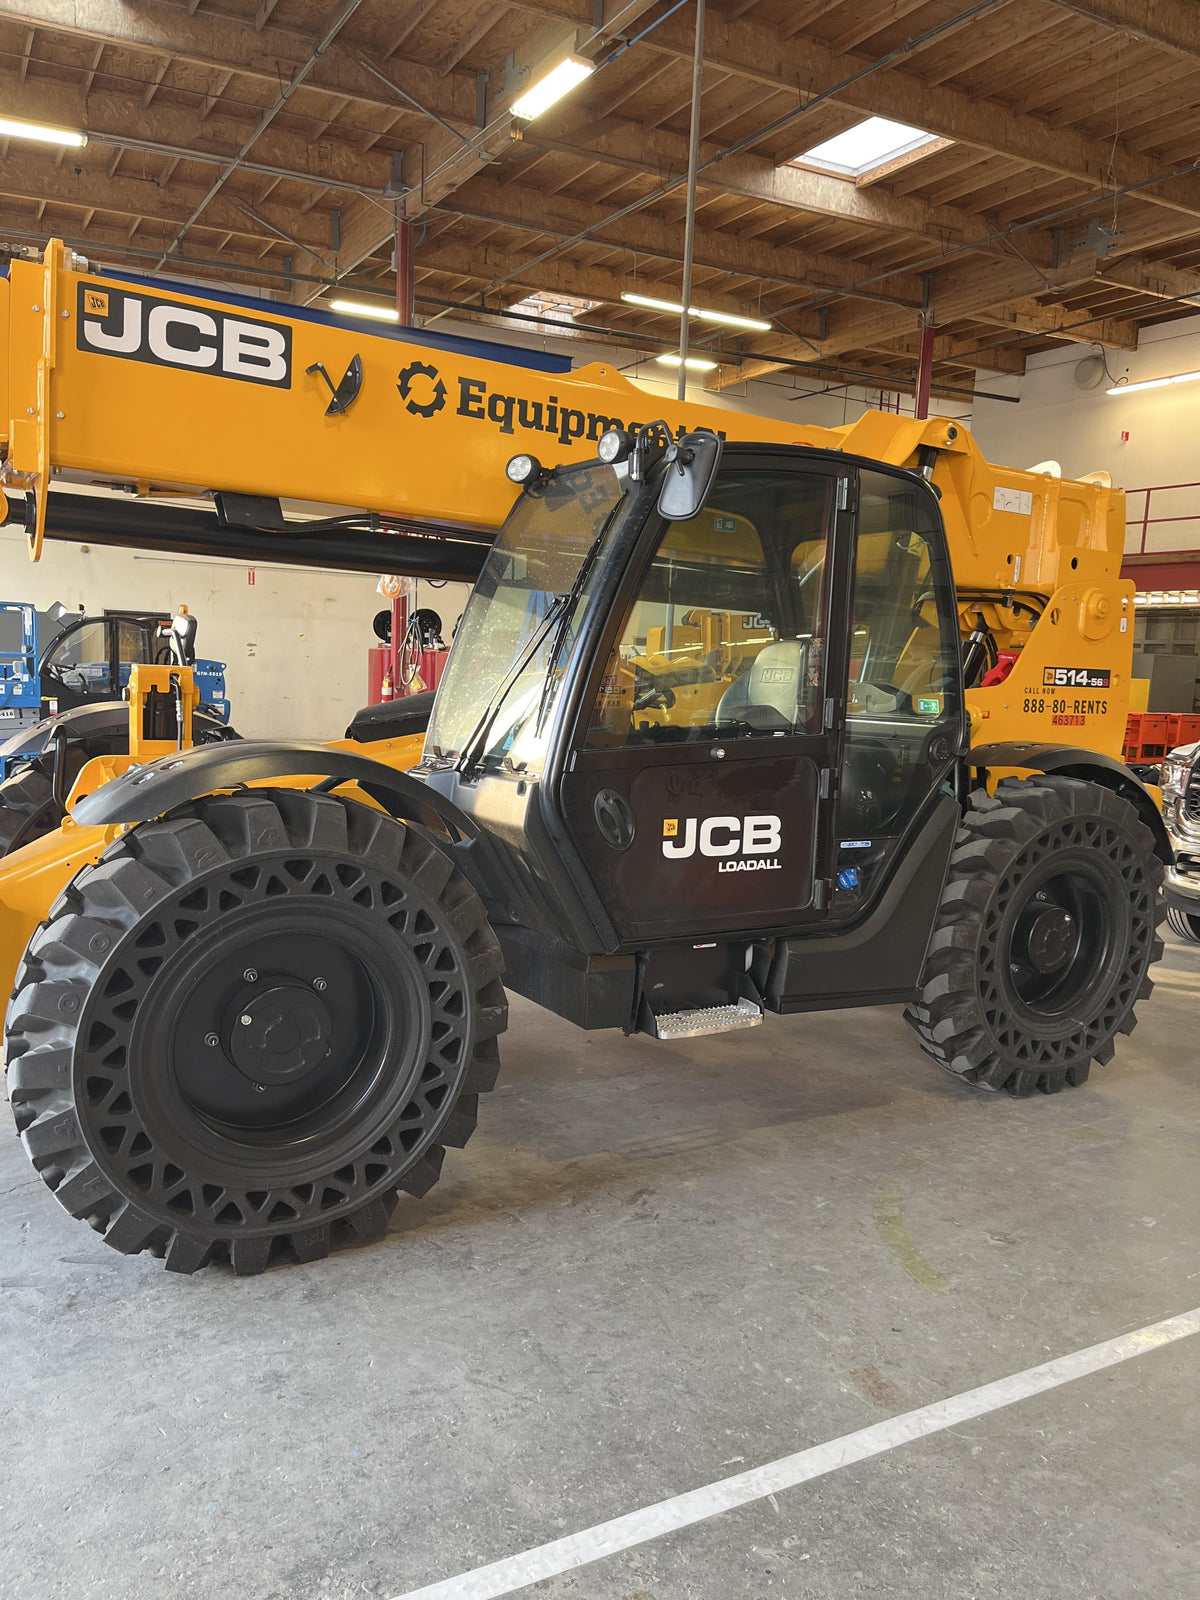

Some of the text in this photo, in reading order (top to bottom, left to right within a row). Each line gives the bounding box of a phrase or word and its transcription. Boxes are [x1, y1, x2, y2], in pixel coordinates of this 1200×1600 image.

[84, 298, 287, 382] JCB
[1024, 687, 1040, 695] CALL
[1023, 698, 1107, 714] 888-80-RENTS
[1052, 715, 1085, 726] 463713
[662, 815, 782, 859] JCB
[718, 859, 782, 873] LOADALL
